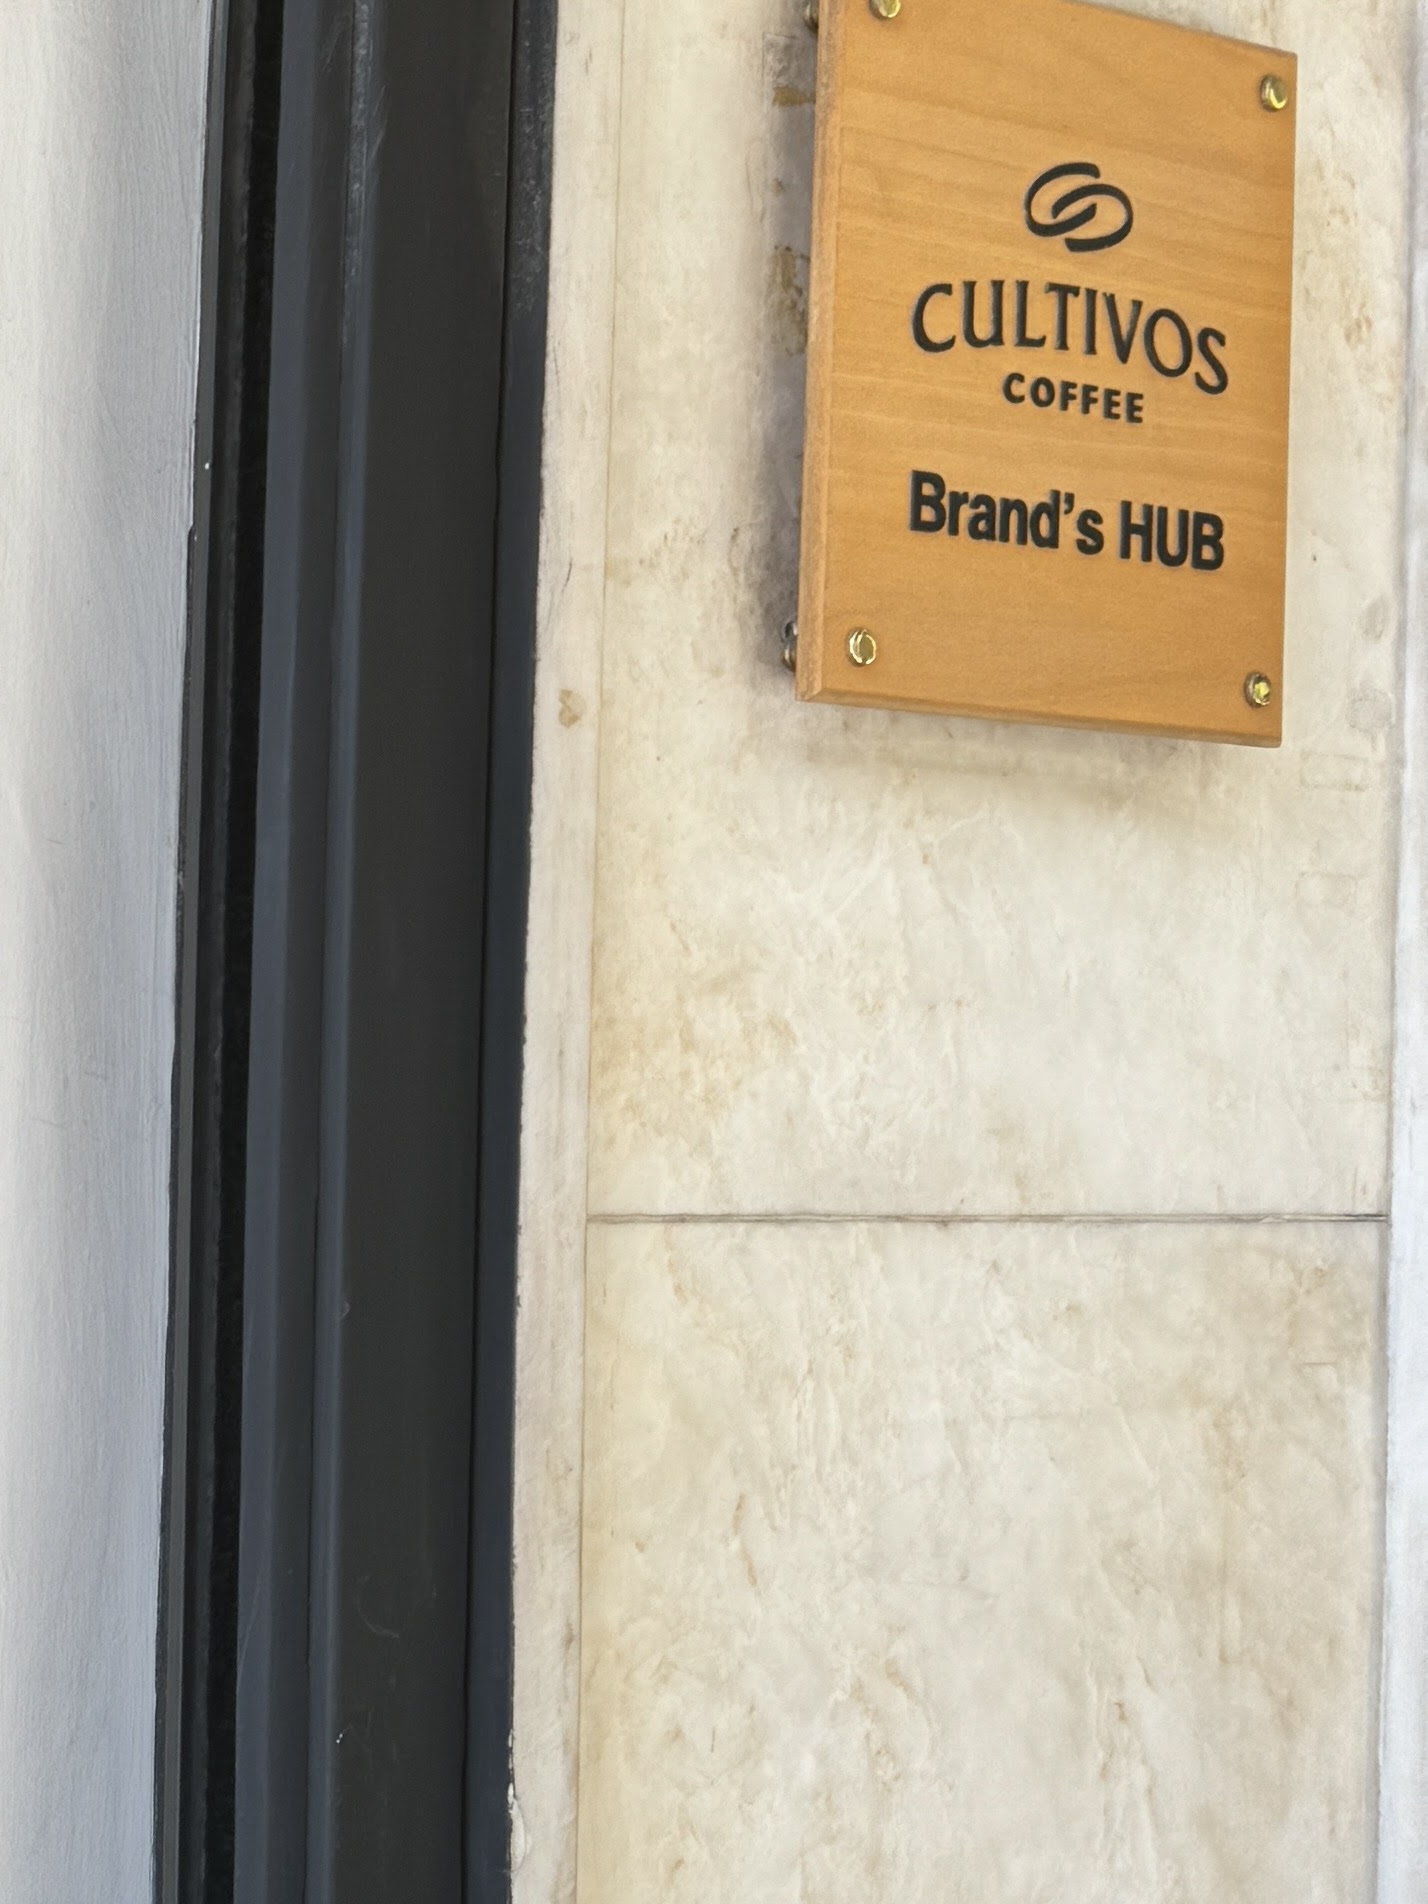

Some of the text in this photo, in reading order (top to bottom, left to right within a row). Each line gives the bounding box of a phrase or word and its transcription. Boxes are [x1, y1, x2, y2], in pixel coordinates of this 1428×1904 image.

[911, 279, 1229, 395] CULTIVOS
[1002, 372, 1144, 424] COFFEE
[1119, 500, 1225, 571] HUB
